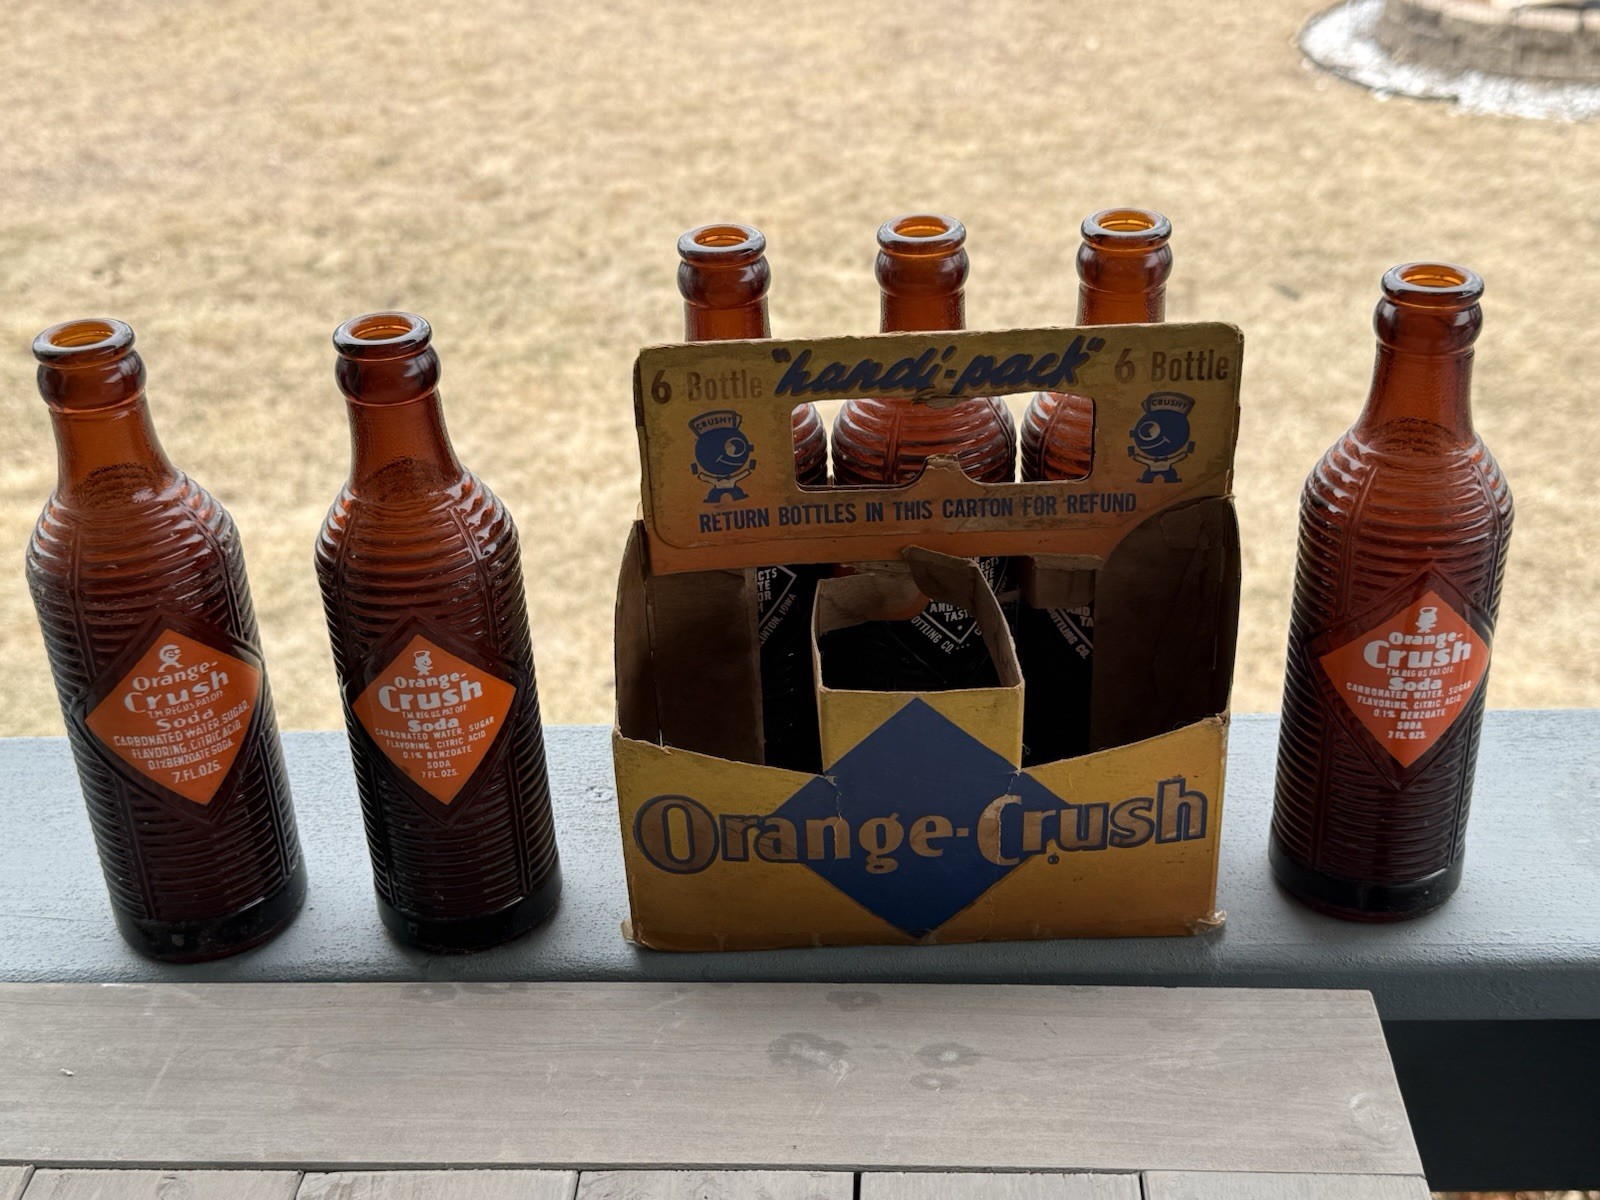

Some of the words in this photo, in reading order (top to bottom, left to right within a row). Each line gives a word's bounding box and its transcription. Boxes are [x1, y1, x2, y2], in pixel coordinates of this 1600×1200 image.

[1114, 348, 1136, 384] 6
[1150, 350, 1229, 382] Bottle
[652, 370, 672, 404] 6
[686, 372, 763, 401] Bottle
[1151, 399, 1188, 410] CRUSHY
[696, 417, 732, 430] CRUSHY
[700, 508, 770, 534] RETURN
[779, 503, 857, 526] BOTTLES
[866, 501, 885, 522] IN
[892, 500, 933, 521] THIS
[942, 498, 1014, 519] CARTON
[1023, 496, 1057, 516] FOR
[1068, 493, 1137, 514] REFUND
[944, 610, 971, 622] TAST
[911, 616, 943, 644] OTTLING
[1388, 632, 1462, 649] Orange-
[1364, 640, 1472, 669] Crush
[133, 661, 218, 691] Orange-
[394, 672, 467, 689] Orange-
[1388, 677, 1443, 691] Soda
[124, 671, 229, 713] Crush
[379, 680, 483, 712] Crush
[156, 709, 214, 732] Soda
[375, 728, 428, 741] CARBONATED
[469, 716, 495, 732] SUGAR
[407, 718, 460, 733] Soda
[113, 728, 183, 747] CARBONATED
[191, 728, 221, 749] CITRIC
[436, 738, 464, 749] CITRIC
[468, 731, 487, 742] ACID
[427, 746, 473, 760] BENZOATE
[426, 760, 451, 769] SODA
